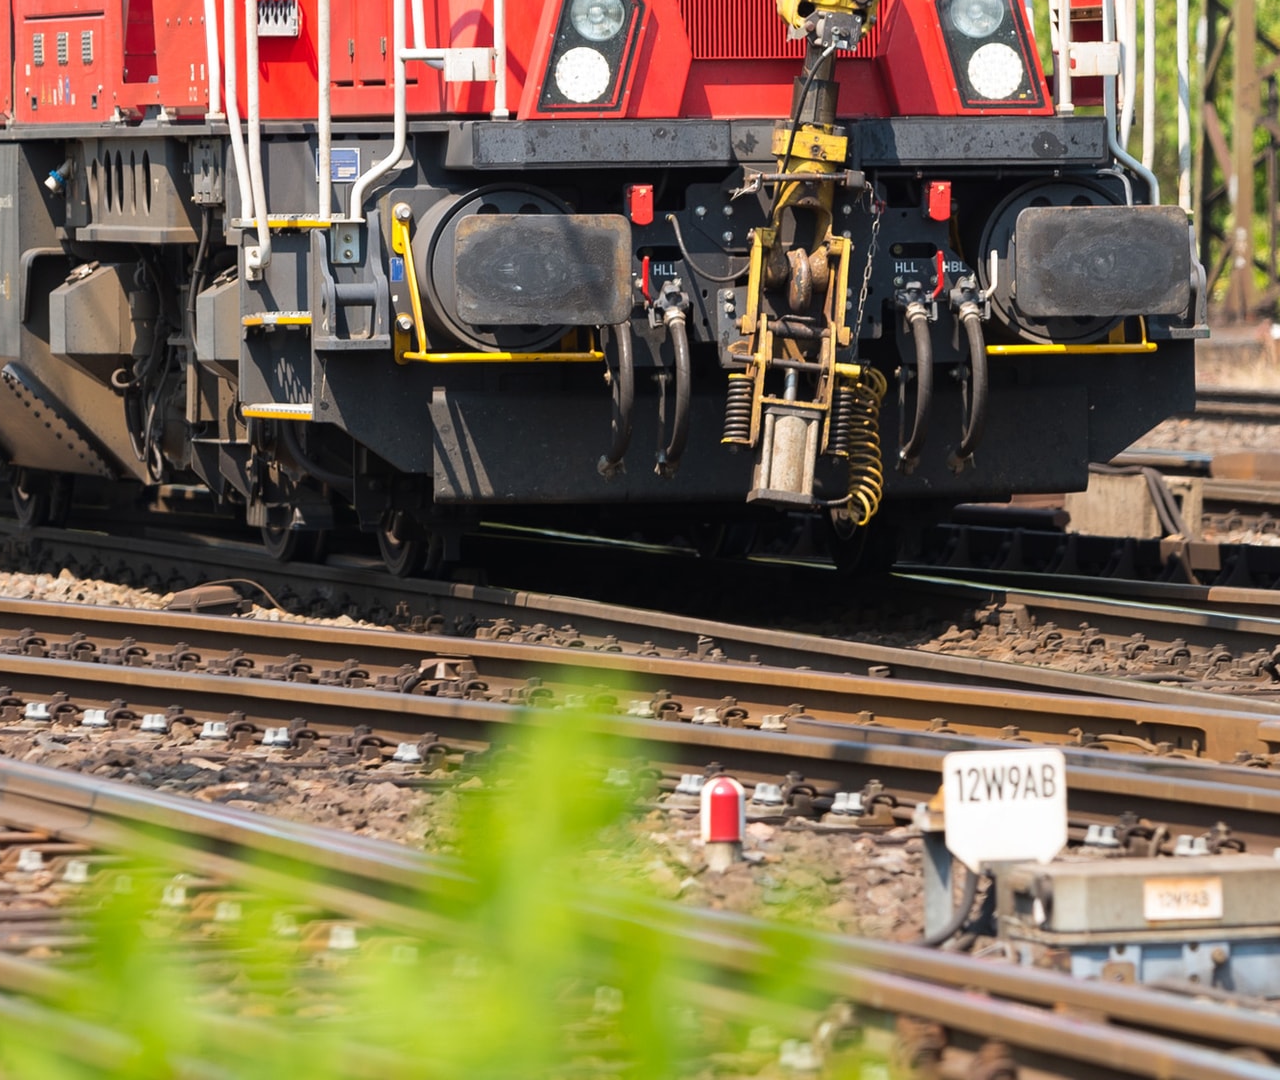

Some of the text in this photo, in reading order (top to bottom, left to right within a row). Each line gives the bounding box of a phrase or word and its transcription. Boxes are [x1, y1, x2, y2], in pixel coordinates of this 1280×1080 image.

[653, 263, 676, 276] HLL
[894, 261, 919, 273] HLL
[942, 260, 967, 273] HBL
[954, 763, 1056, 802] 12W9AB
